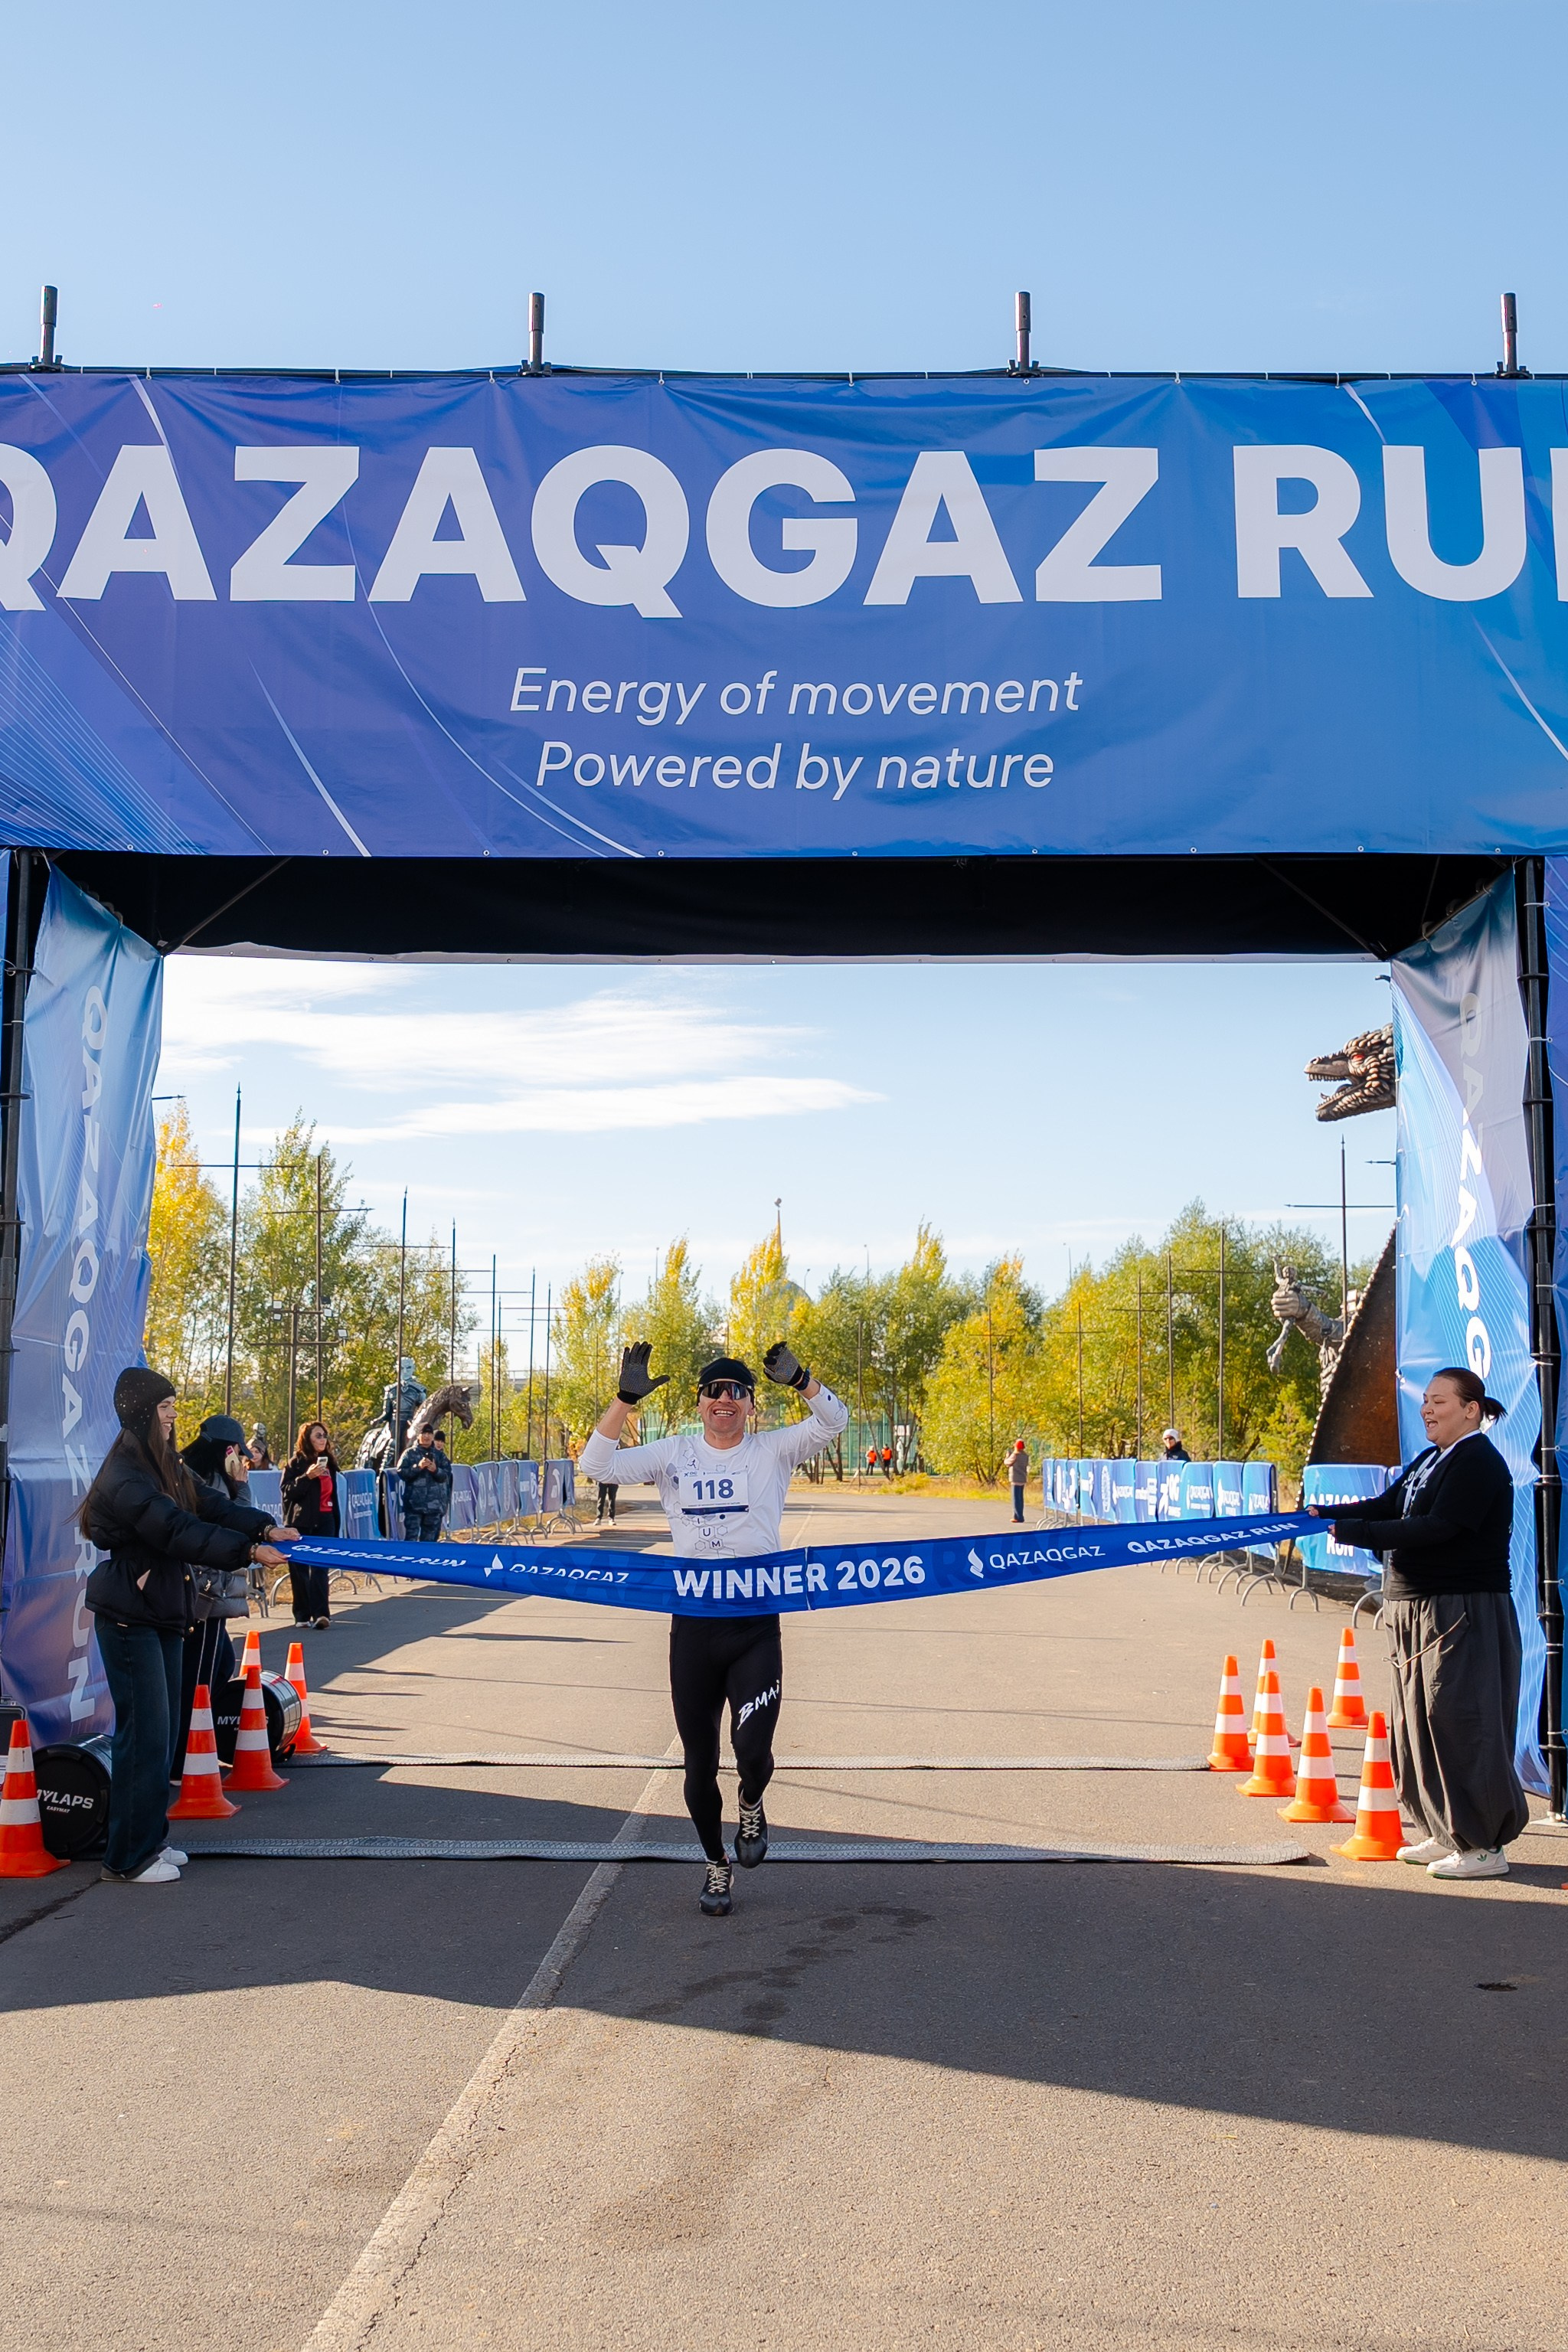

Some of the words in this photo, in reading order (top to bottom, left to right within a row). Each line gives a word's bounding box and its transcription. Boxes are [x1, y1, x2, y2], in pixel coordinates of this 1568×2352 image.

[1233, 444, 1568, 603] RU
[510, 667, 707, 726] Energy
[720, 670, 777, 715] of
[788, 671, 1083, 715] movement
[537, 740, 782, 789] Powered
[795, 742, 866, 802] by
[875, 746, 1054, 789] nature
[1450, 992, 1492, 1380] QAZAQG
[61, 985, 108, 1496] QAZAQGAZ
[693, 1478, 734, 1500] 118
[291, 1544, 415, 1563] QAZAQGAZ
[411, 1557, 467, 1567] RUN
[989, 1545, 1106, 1570] QAZAQGAZ
[1127, 1530, 1252, 1554] QAZAQGAZ
[1249, 1522, 1300, 1537] RUN
[672, 1563, 829, 1599] WINNER
[835, 1555, 926, 1591] 2026
